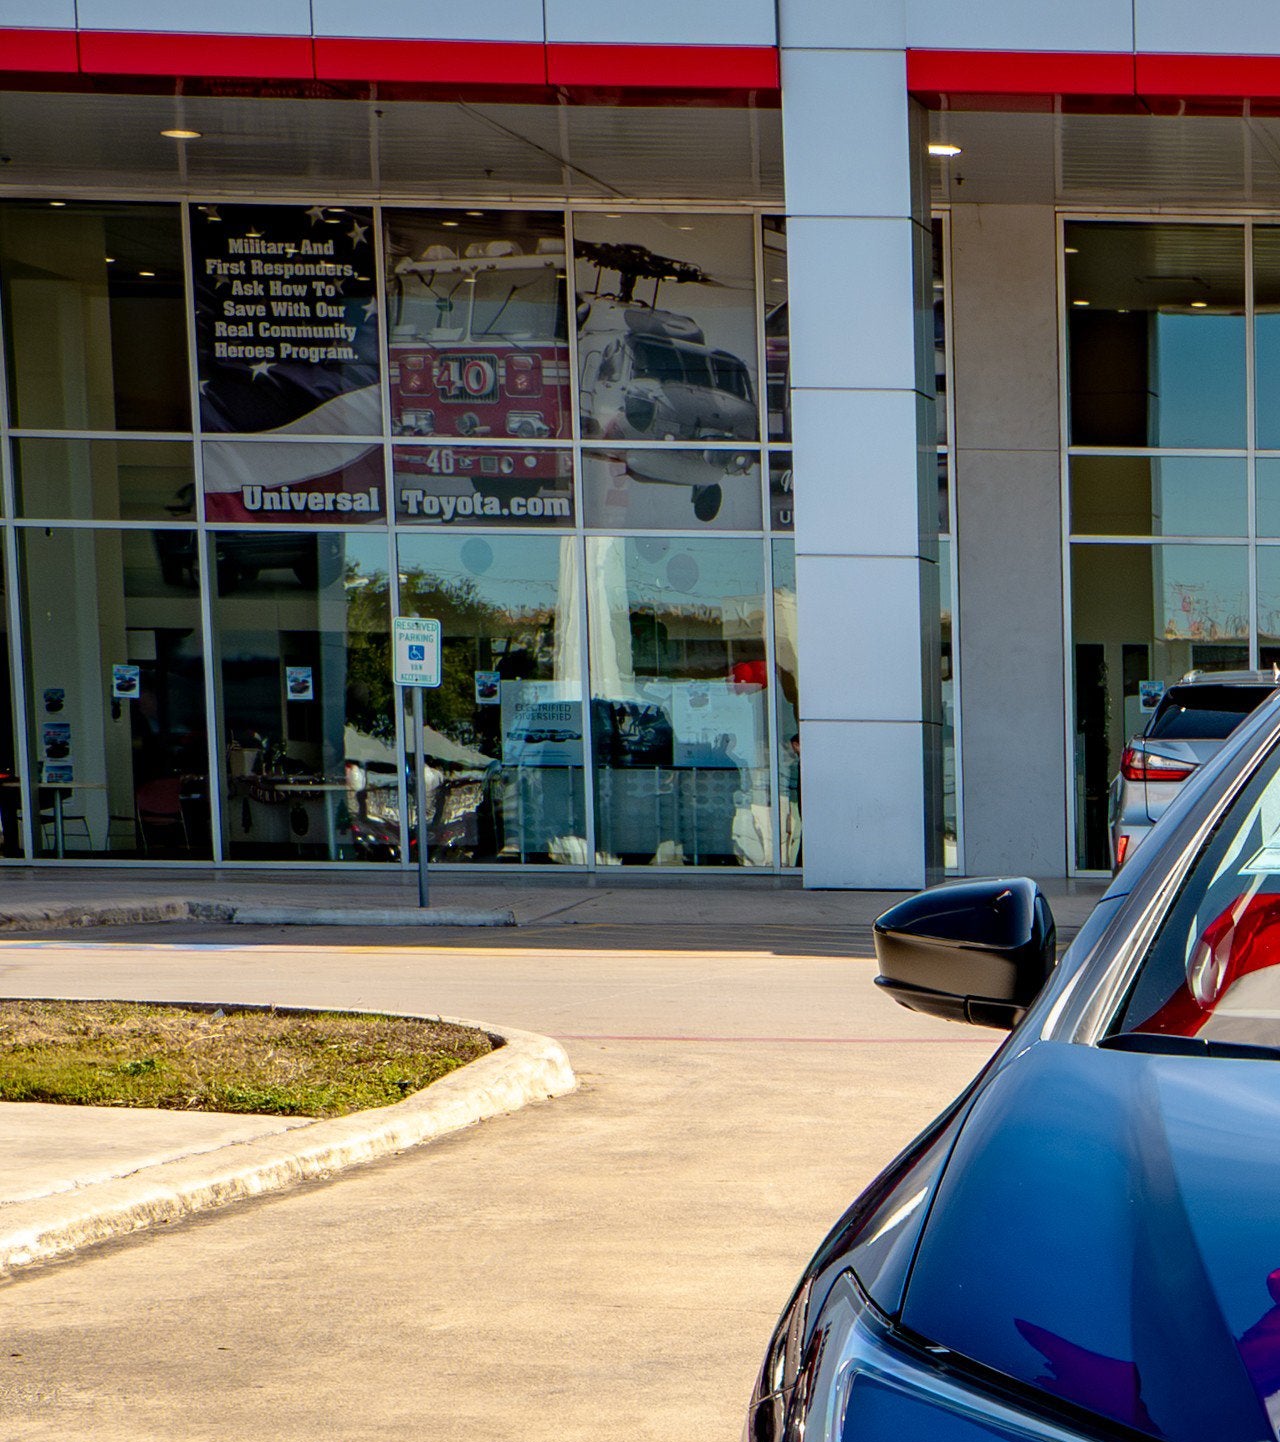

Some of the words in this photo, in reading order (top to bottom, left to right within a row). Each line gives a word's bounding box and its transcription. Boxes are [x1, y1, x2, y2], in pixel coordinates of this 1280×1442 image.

[228, 238, 295, 258] Military
[301, 239, 335, 255] And
[205, 258, 246, 275] First
[251, 259, 359, 279] Responders,
[231, 280, 264, 296] Ask
[269, 280, 307, 297] How
[312, 281, 336, 297] To
[223, 300, 267, 317] Save
[271, 301, 311, 318] With
[315, 301, 346, 318] Our
[214, 321, 254, 338] Real
[258, 321, 357, 342] Community
[214, 342, 275, 358] Heroes
[279, 343, 359, 363] Program.
[432, 359, 494, 397] 40
[426, 448, 454, 474] 40
[241, 485, 380, 512] Universal
[401, 489, 571, 521] Toyota.com
[396, 621, 437, 632] RESERVED
[398, 632, 434, 643] PARKING
[514, 712, 572, 721] DIVERSIFIED
[515, 703, 572, 712] ELECTRIFIED
